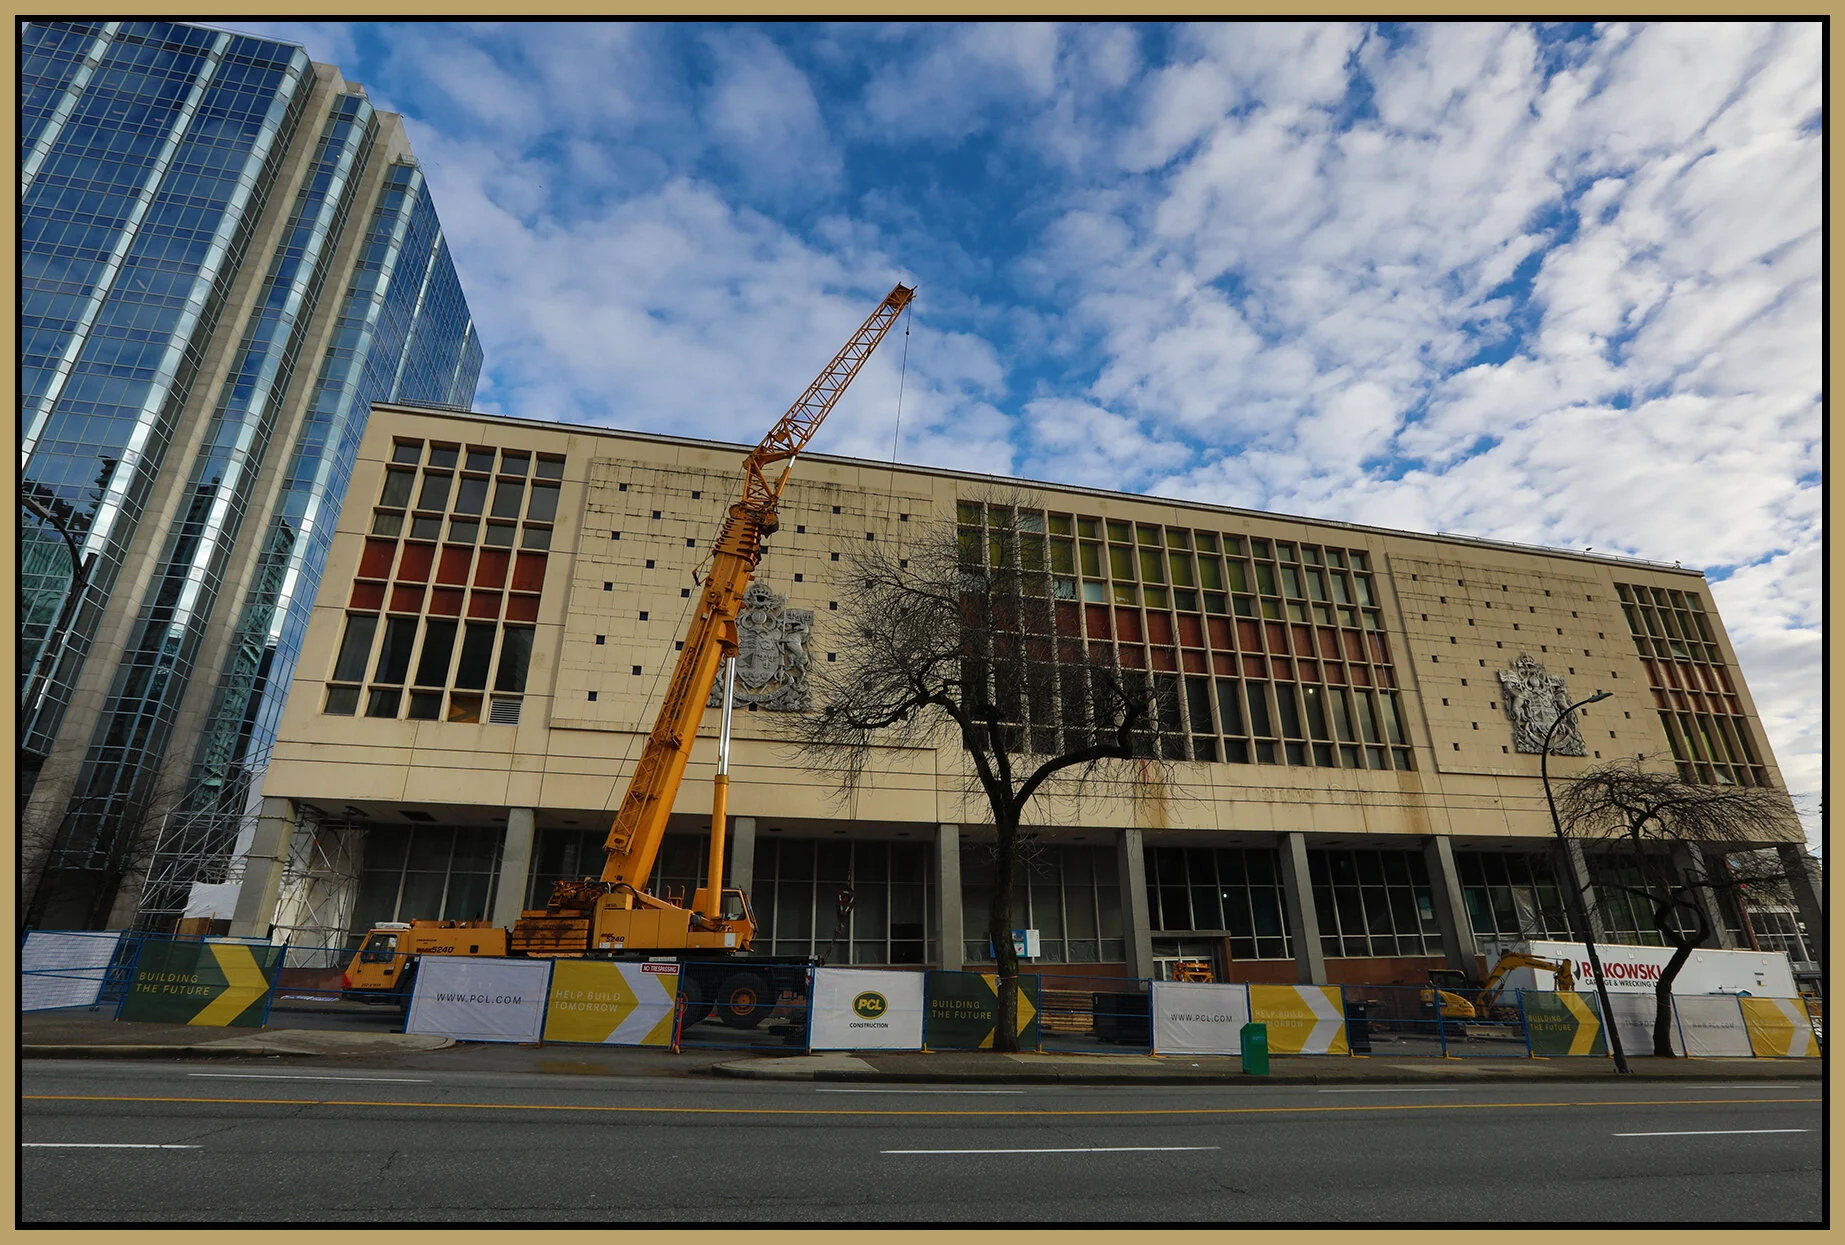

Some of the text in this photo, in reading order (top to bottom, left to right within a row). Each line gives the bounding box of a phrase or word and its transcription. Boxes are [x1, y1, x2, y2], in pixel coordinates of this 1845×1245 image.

[650, 965, 677, 973] TRESPASSING
[1581, 962, 1663, 980] RKOWSKI
[139, 971, 199, 983] BUILDING
[1585, 979, 1613, 987] CARGE
[1620, 980, 1651, 988] WRECKING
[136, 983, 210, 996] THE FUTURE
[436, 992, 521, 1005] WWW.PCL.COM
[555, 990, 621, 1001] HELP BUILD
[555, 1001, 618, 1013] TOMORROW
[858, 998, 882, 1010] PCL
[932, 1000, 980, 1009] BUILDING
[932, 1010, 992, 1020] THE FUTURE
[1170, 1013, 1233, 1023] WWW.PCL.COM
[1255, 1009, 1304, 1019] HELP BUILD
[1528, 1015, 1562, 1023] BUILDING
[1256, 1020, 1304, 1029] MORROW
[1530, 1023, 1572, 1032] THE FUTURE
